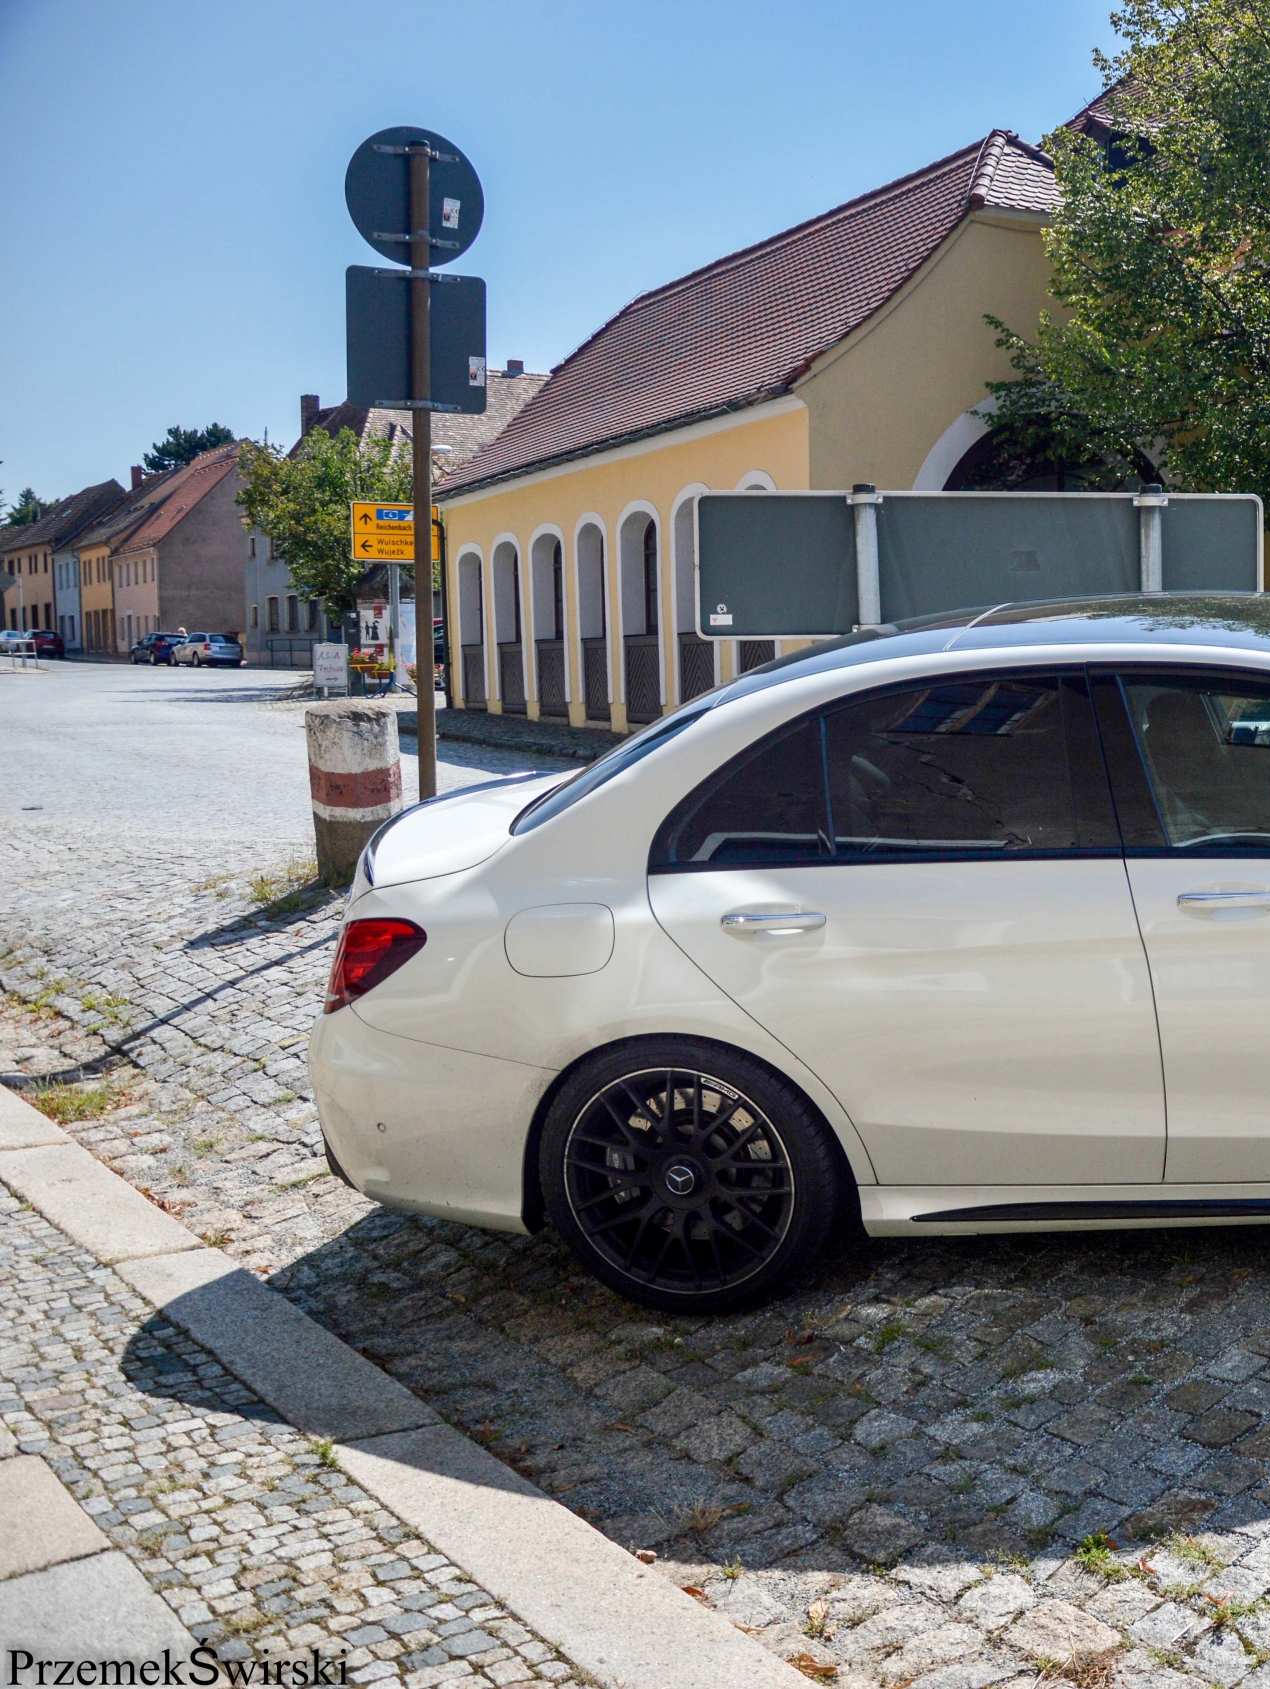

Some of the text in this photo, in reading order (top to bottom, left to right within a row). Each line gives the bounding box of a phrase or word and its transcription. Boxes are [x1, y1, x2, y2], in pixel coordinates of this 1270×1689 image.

[376, 523, 412, 531] Reichenbach
[377, 538, 414, 546] Wuischke
[377, 547, 405, 557] Wuježk
